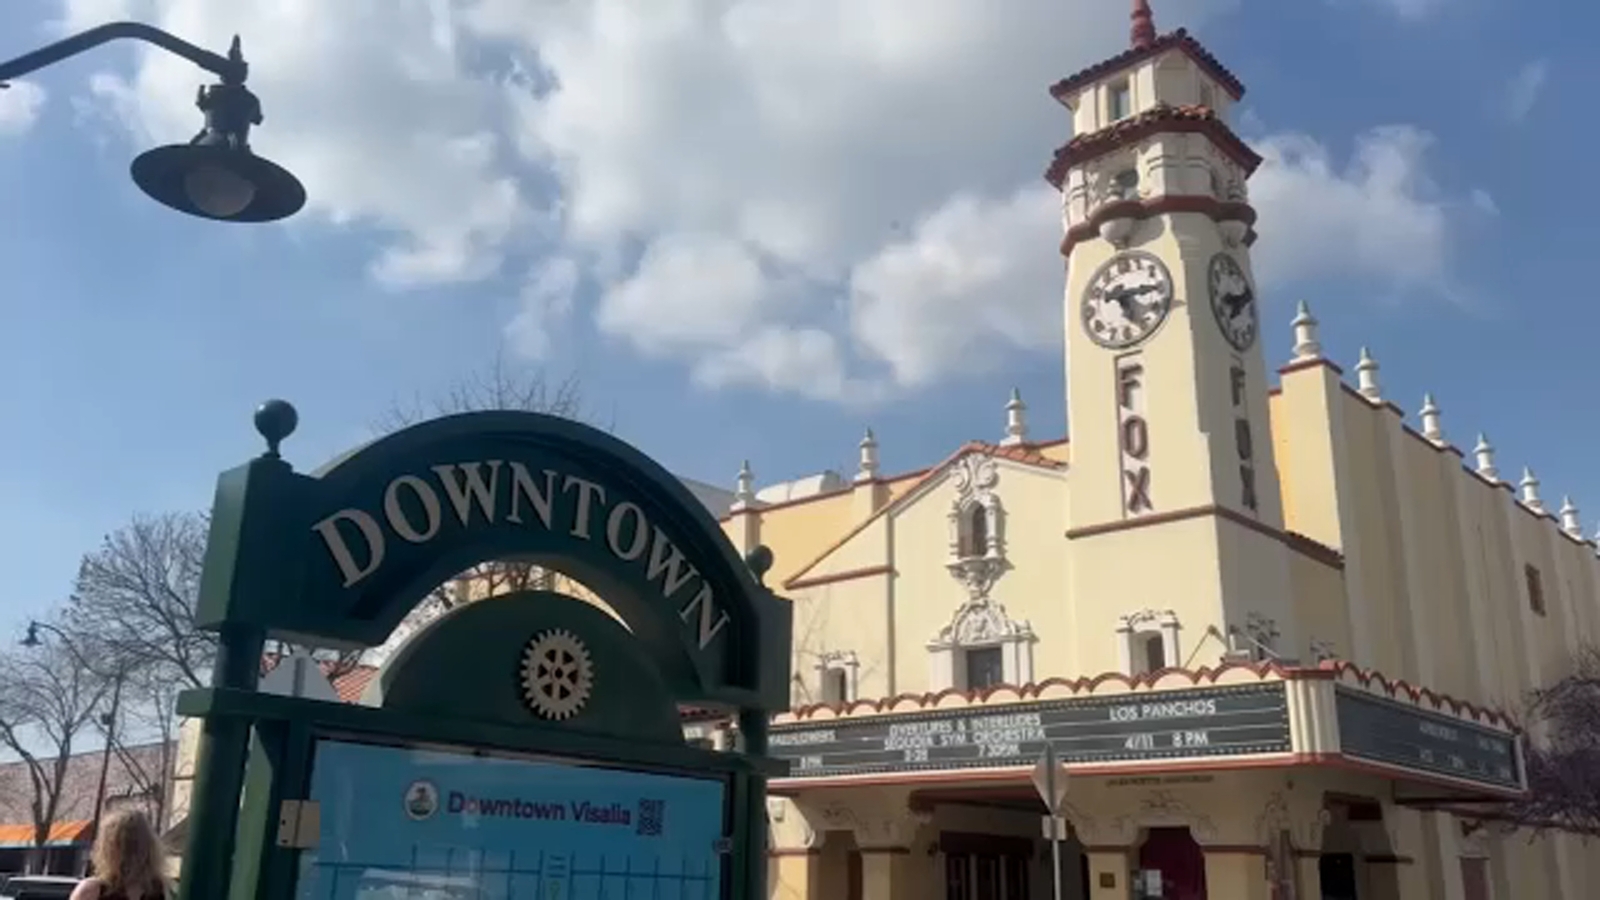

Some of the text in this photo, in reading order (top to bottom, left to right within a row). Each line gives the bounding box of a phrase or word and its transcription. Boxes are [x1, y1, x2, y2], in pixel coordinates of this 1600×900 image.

[1120, 363, 1153, 511] FOX
[312, 460, 731, 652] DOWNTOWN
[1109, 700, 1216, 721] LOS PANCHOS
[1125, 731, 1209, 750] 4/11 8 PM
[448, 790, 631, 826] Downtown Visalia
